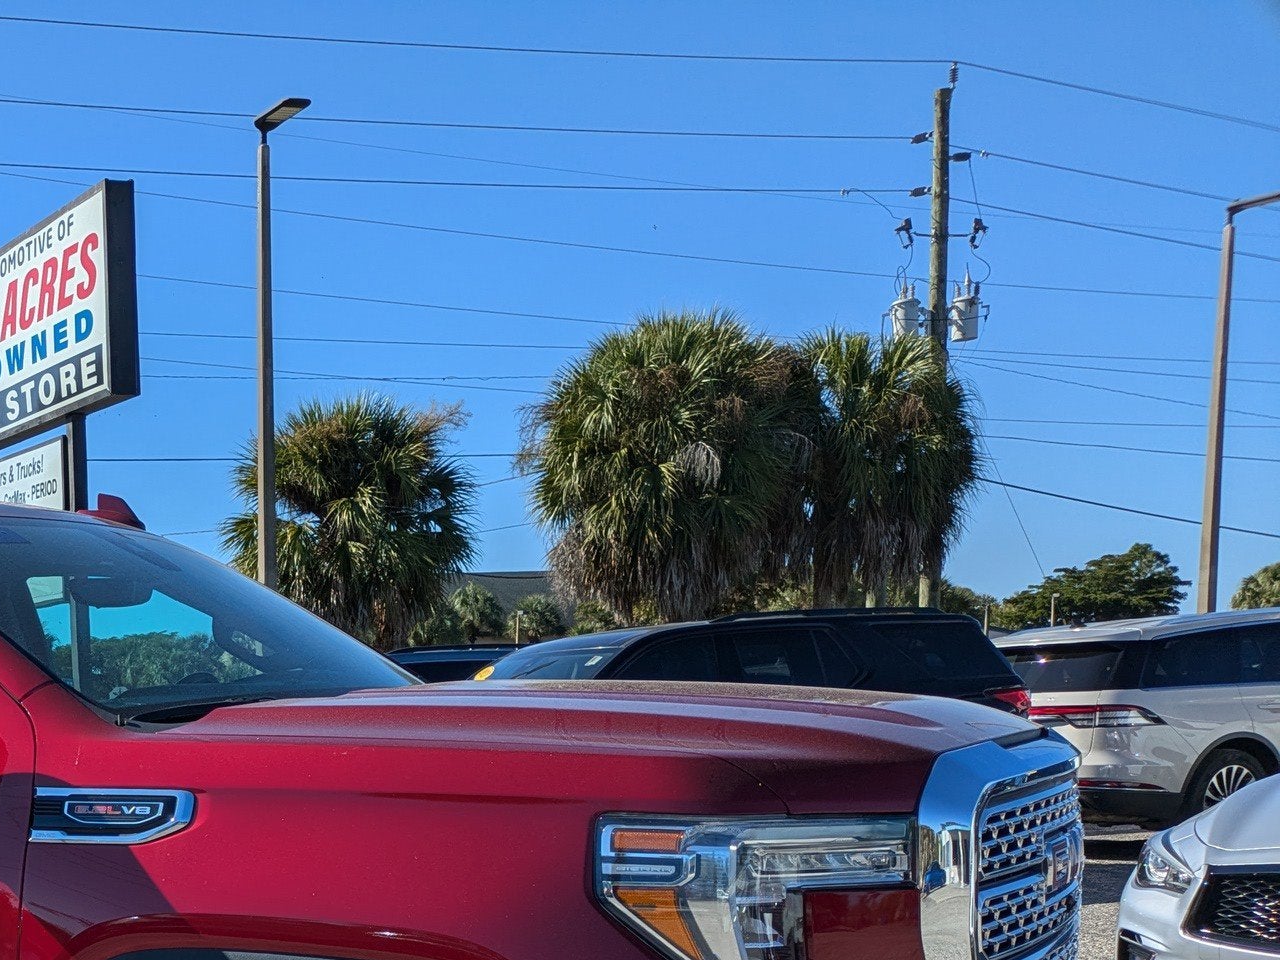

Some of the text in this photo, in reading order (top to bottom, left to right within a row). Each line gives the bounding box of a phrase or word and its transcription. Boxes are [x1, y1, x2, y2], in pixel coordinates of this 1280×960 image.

[57, 214, 74, 242] OF
[0, 232, 99, 342] ACRES
[6, 352, 98, 420] STORE
[9, 465, 14, 483] &
[17, 454, 44, 480] Trucks!
[31, 478, 58, 500] PERIOD
